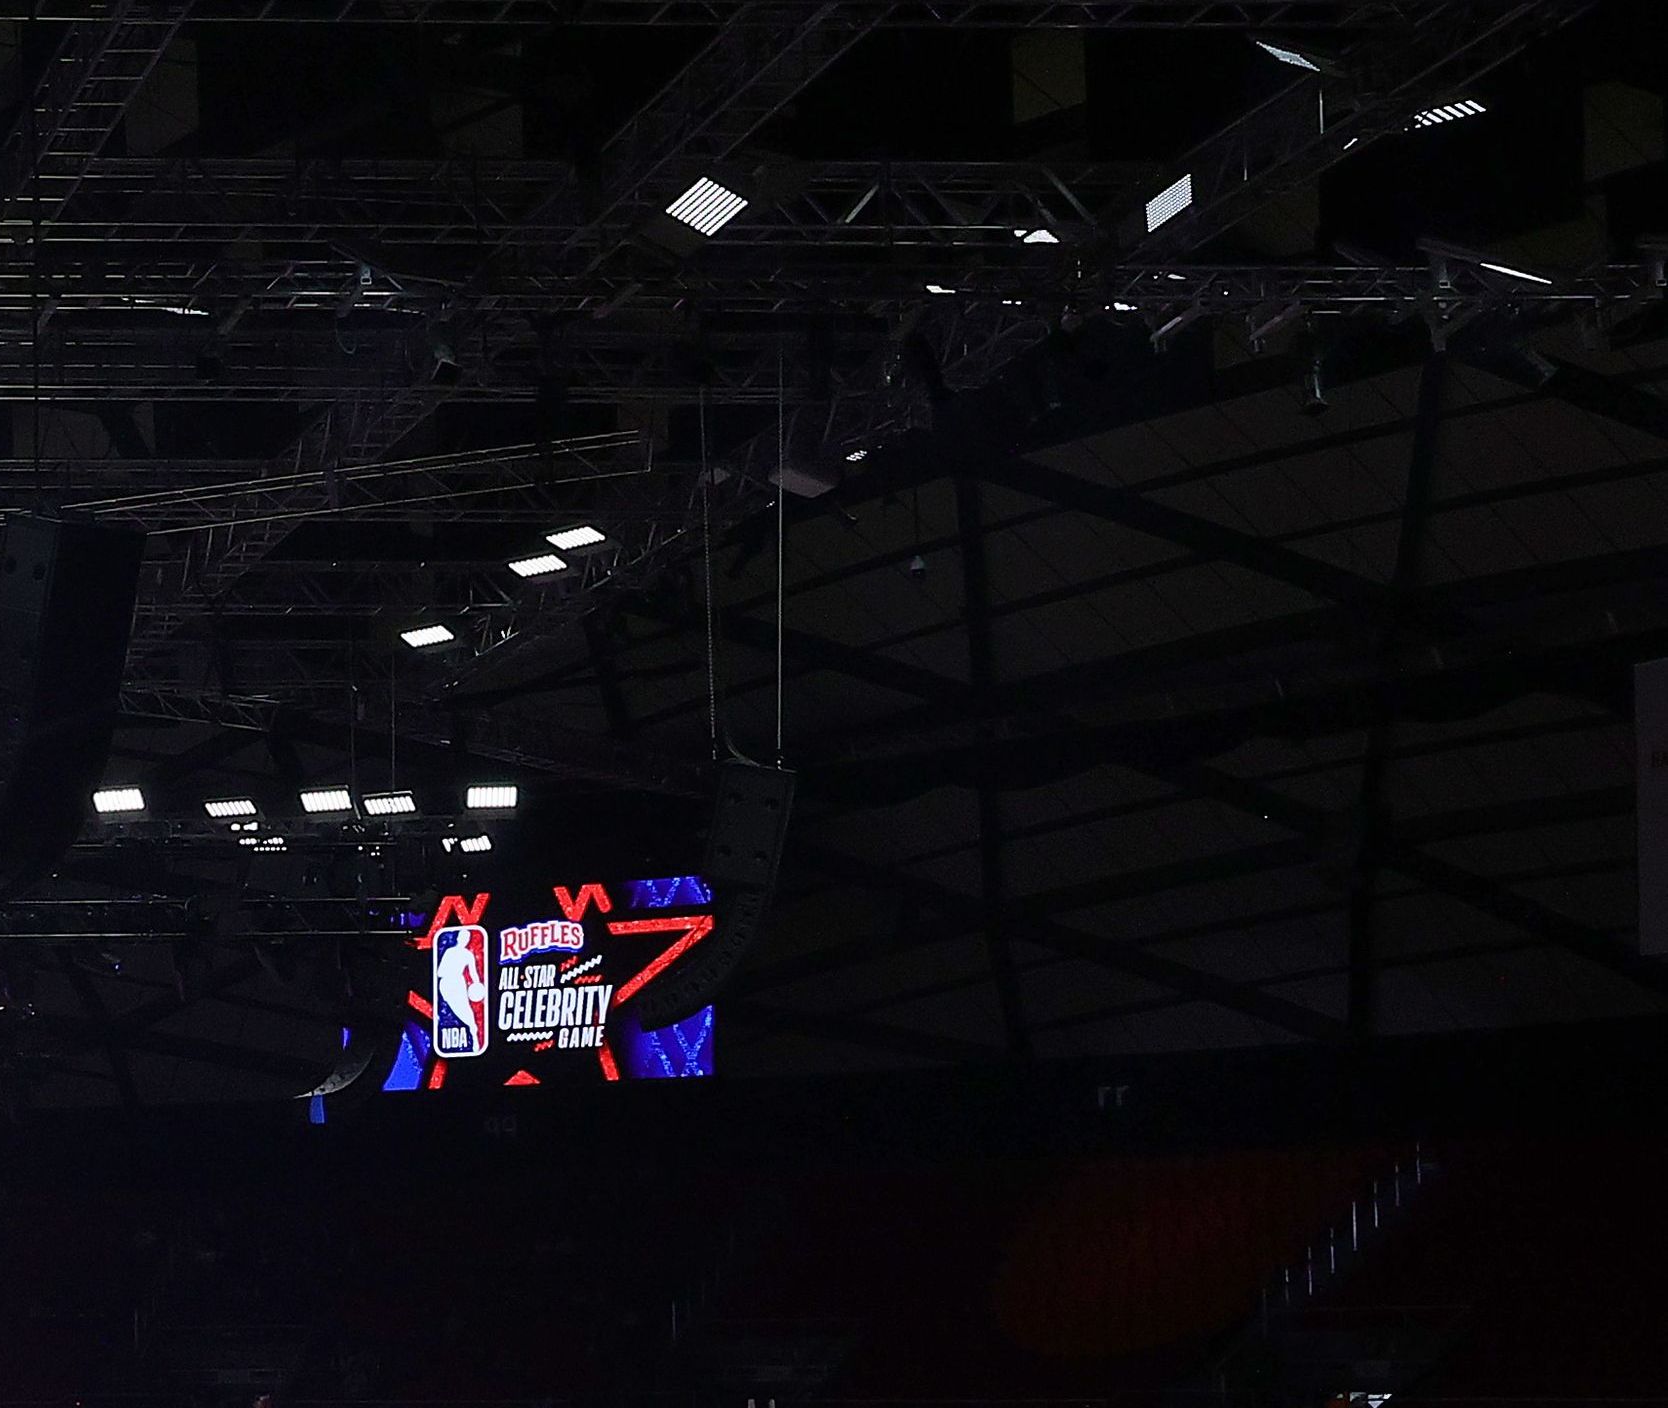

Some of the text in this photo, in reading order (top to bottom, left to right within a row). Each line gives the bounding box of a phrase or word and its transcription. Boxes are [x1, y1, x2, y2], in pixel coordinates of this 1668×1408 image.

[502, 922, 584, 958] RUFFLES
[498, 985, 613, 1031] CELEBRITY
[441, 1028, 468, 1048] NBA
[558, 1026, 605, 1049] GAME
